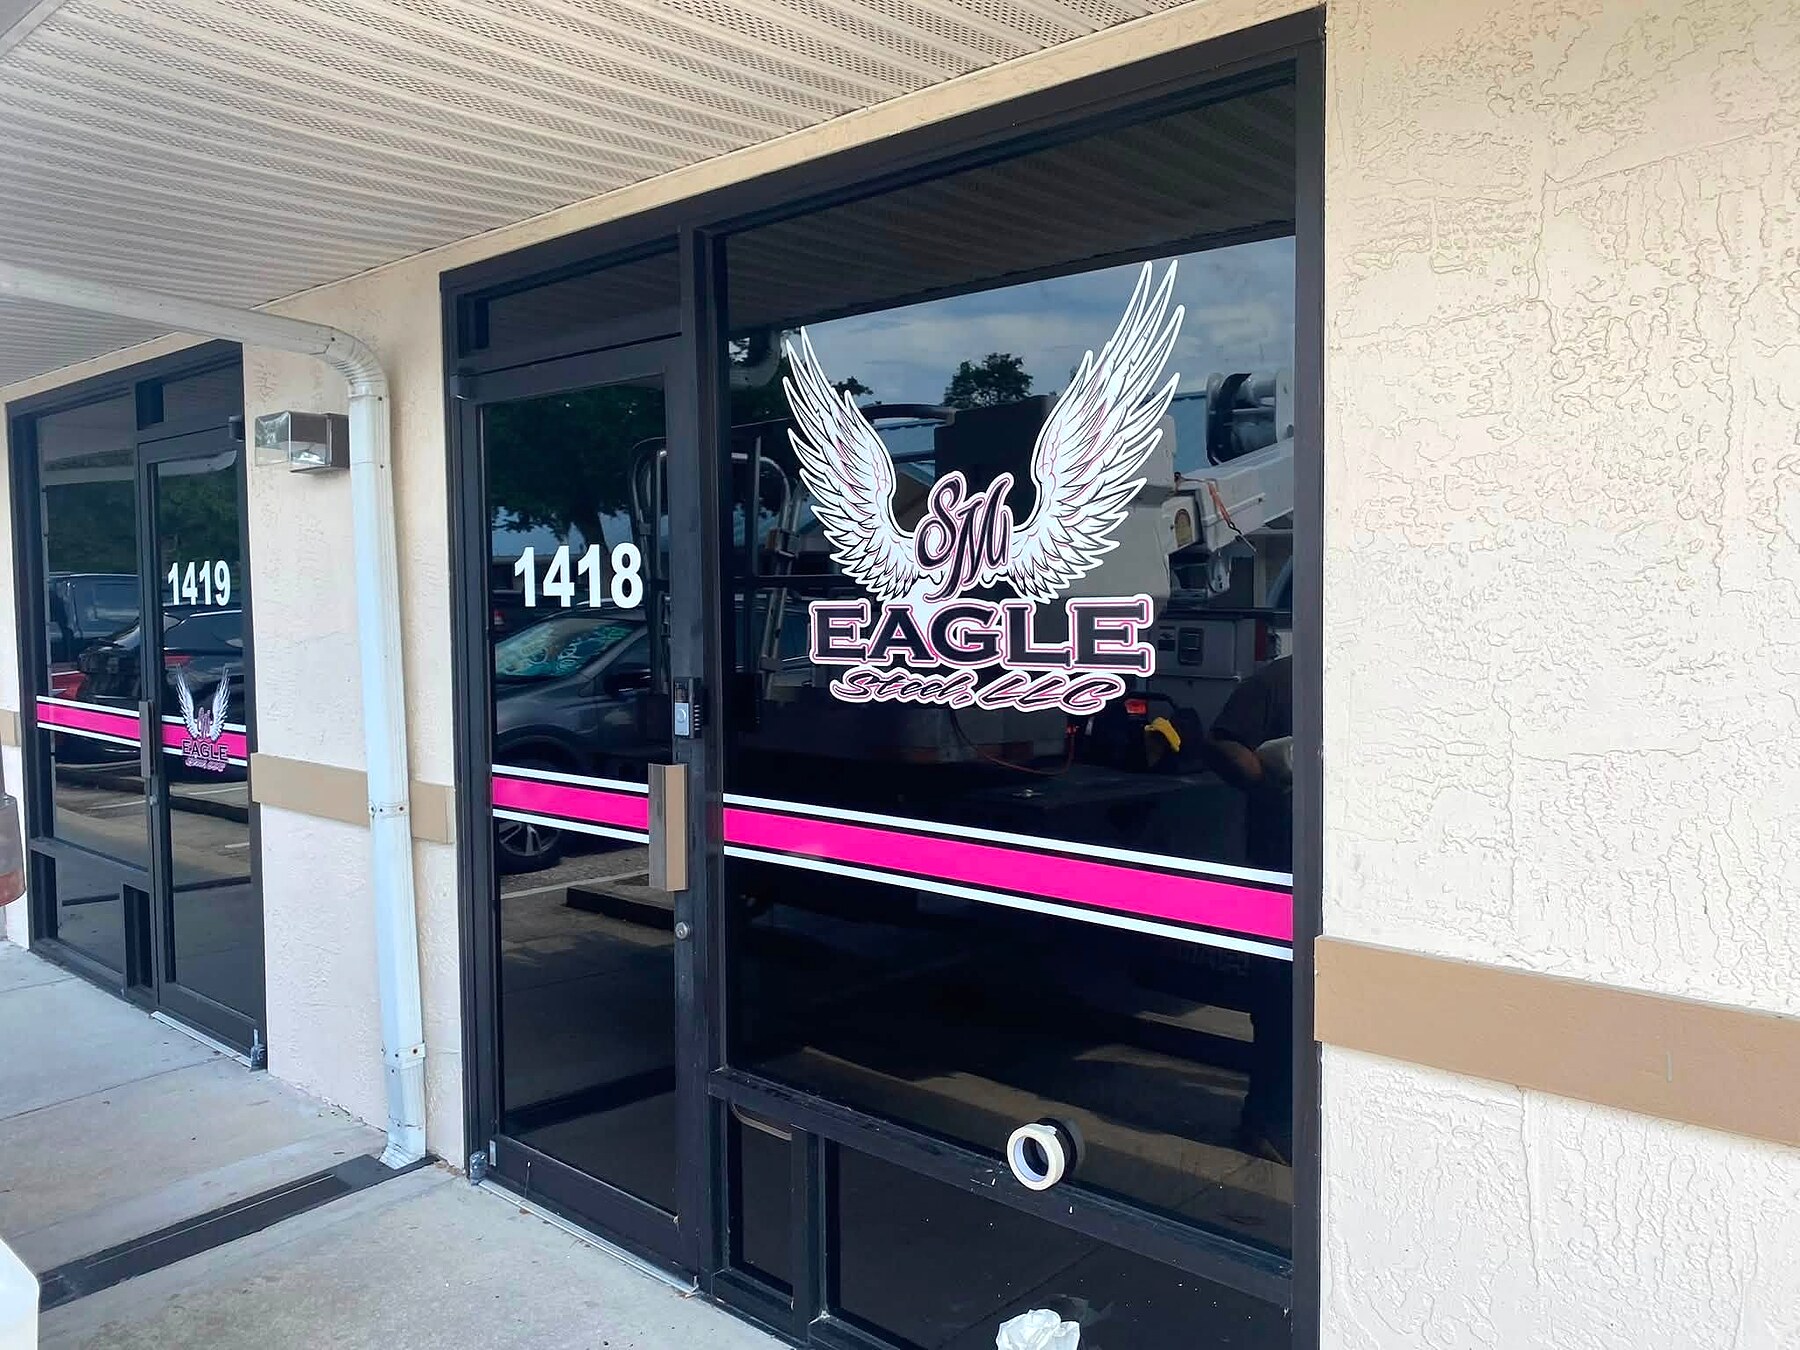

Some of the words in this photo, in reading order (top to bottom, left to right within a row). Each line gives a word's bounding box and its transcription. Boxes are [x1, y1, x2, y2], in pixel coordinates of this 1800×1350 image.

[168, 560, 231, 606] 1419
[514, 542, 643, 609] 1418
[812, 601, 1152, 673] EAGLE
[978, 674, 1123, 712] LLC
[181, 740, 229, 761] EAGLE
